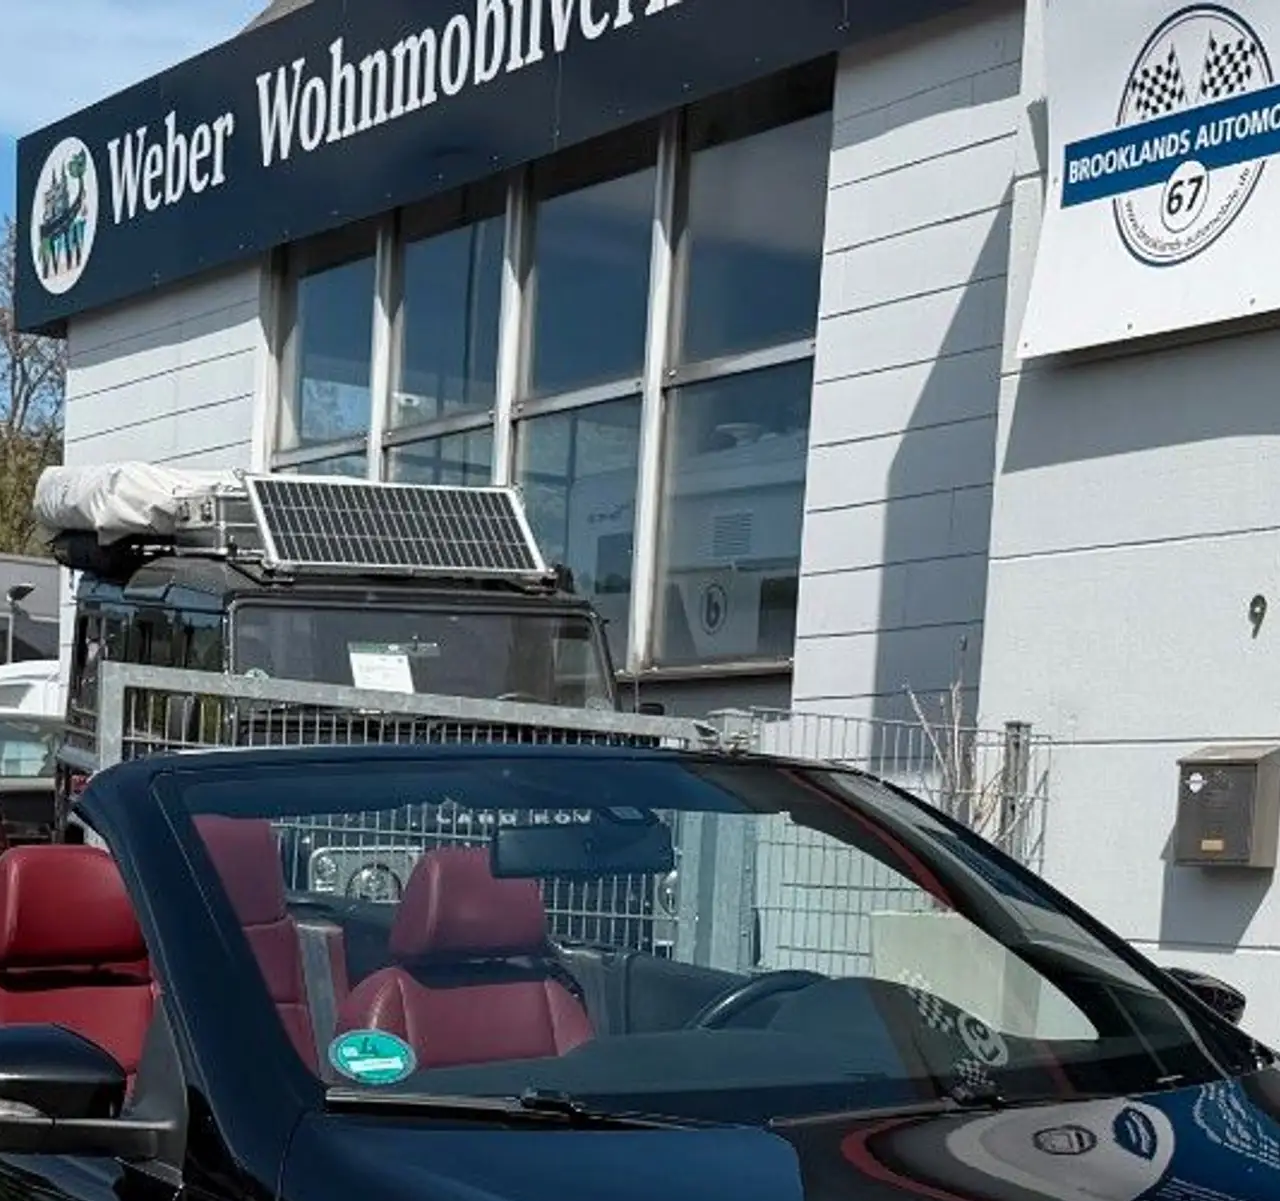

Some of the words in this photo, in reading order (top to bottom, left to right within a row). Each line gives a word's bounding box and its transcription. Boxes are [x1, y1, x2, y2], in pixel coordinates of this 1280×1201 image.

[108, 110, 234, 225] Weber
[1069, 129, 1191, 184] BROOKLANDS
[1165, 175, 1204, 216] 67
[1248, 593, 1268, 640] 9
